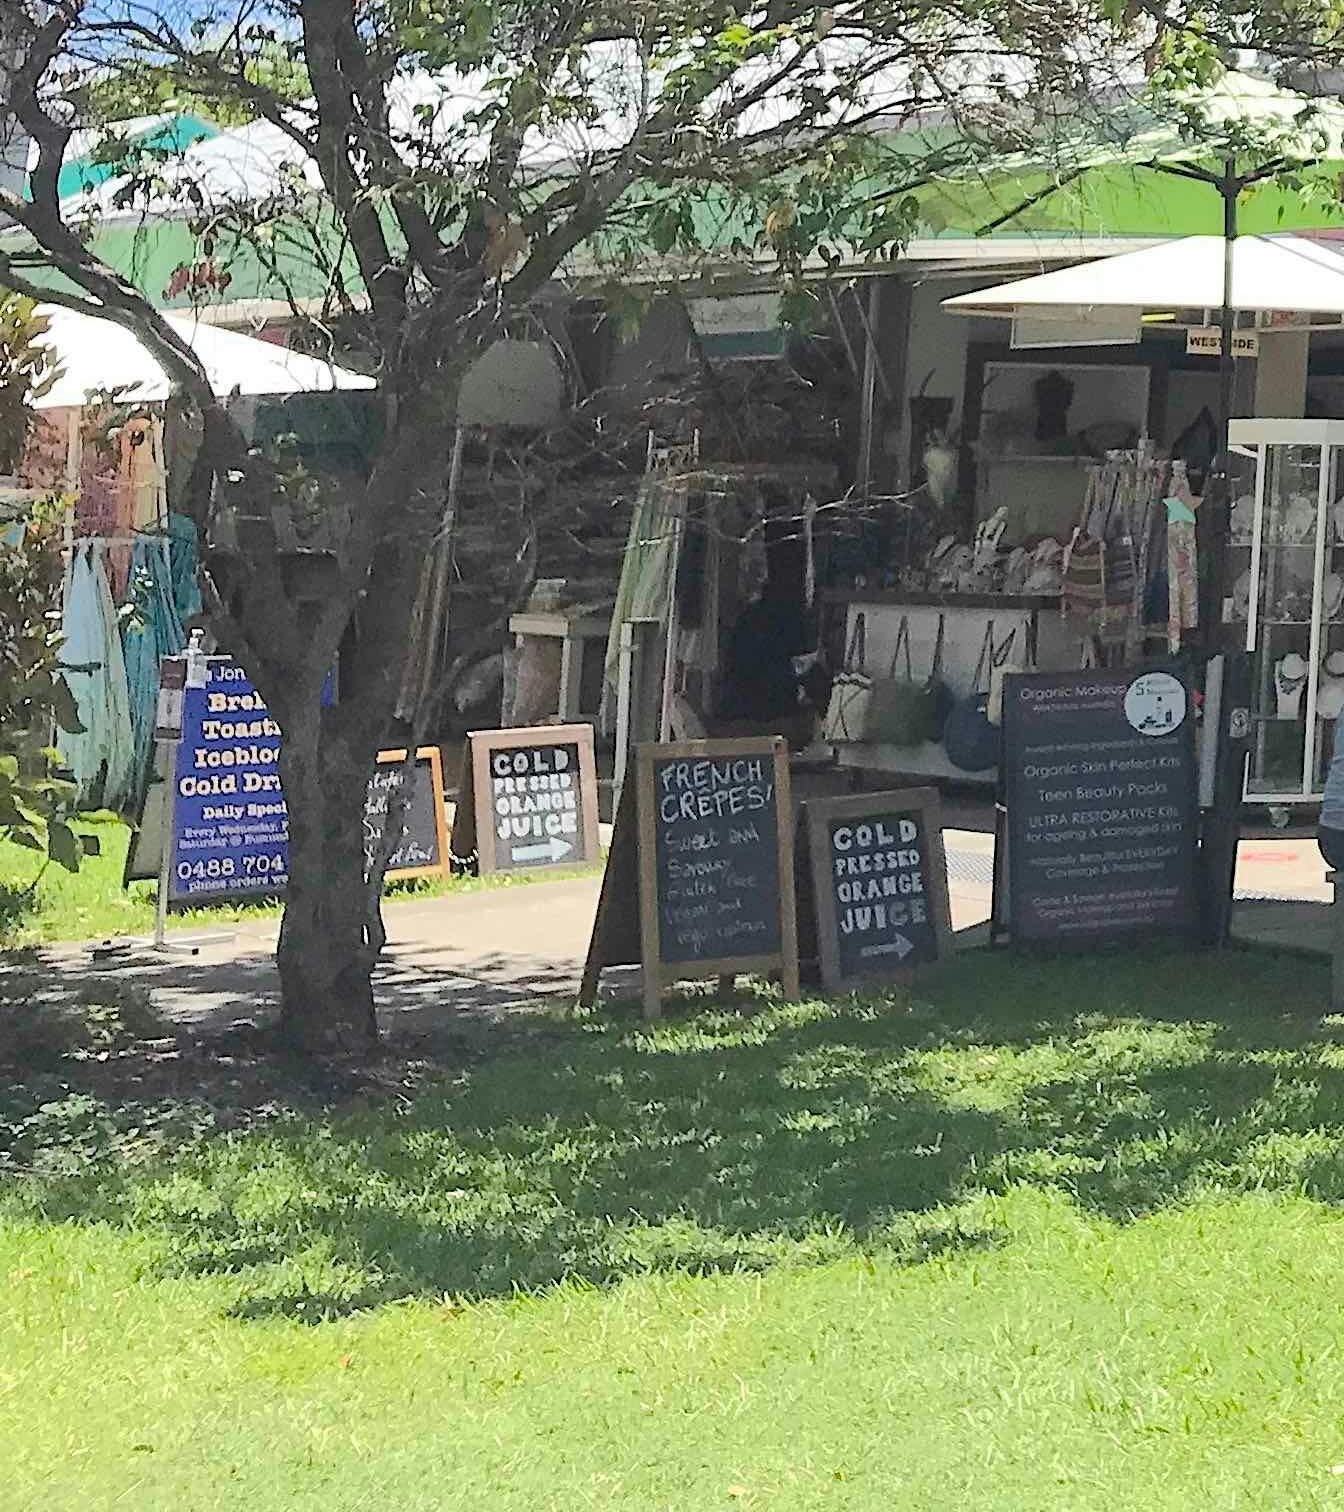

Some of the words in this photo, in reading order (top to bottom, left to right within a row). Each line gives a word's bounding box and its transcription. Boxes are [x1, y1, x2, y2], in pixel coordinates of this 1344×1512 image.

[1020, 686, 1073, 701] Organic
[493, 749, 570, 777] COLD
[660, 759, 763, 792] FRENCH
[1024, 763, 1077, 779] Organic
[1081, 760, 1107, 775] Skin
[179, 774, 237, 797] Cold
[1038, 788, 1073, 802] Teen
[1076, 785, 1122, 801] Beauty
[1128, 780, 1168, 796] Packs
[202, 804, 245, 821] Daily
[497, 811, 578, 840] JUICE
[1028, 813, 1068, 828] ULTRA
[832, 819, 918, 851] COLD
[177, 857, 236, 881] 0488
[242, 853, 286, 875] 704
[834, 848, 921, 877] PRESSED
[836, 871, 925, 903] ORANGE
[839, 898, 927, 935] JUICE
